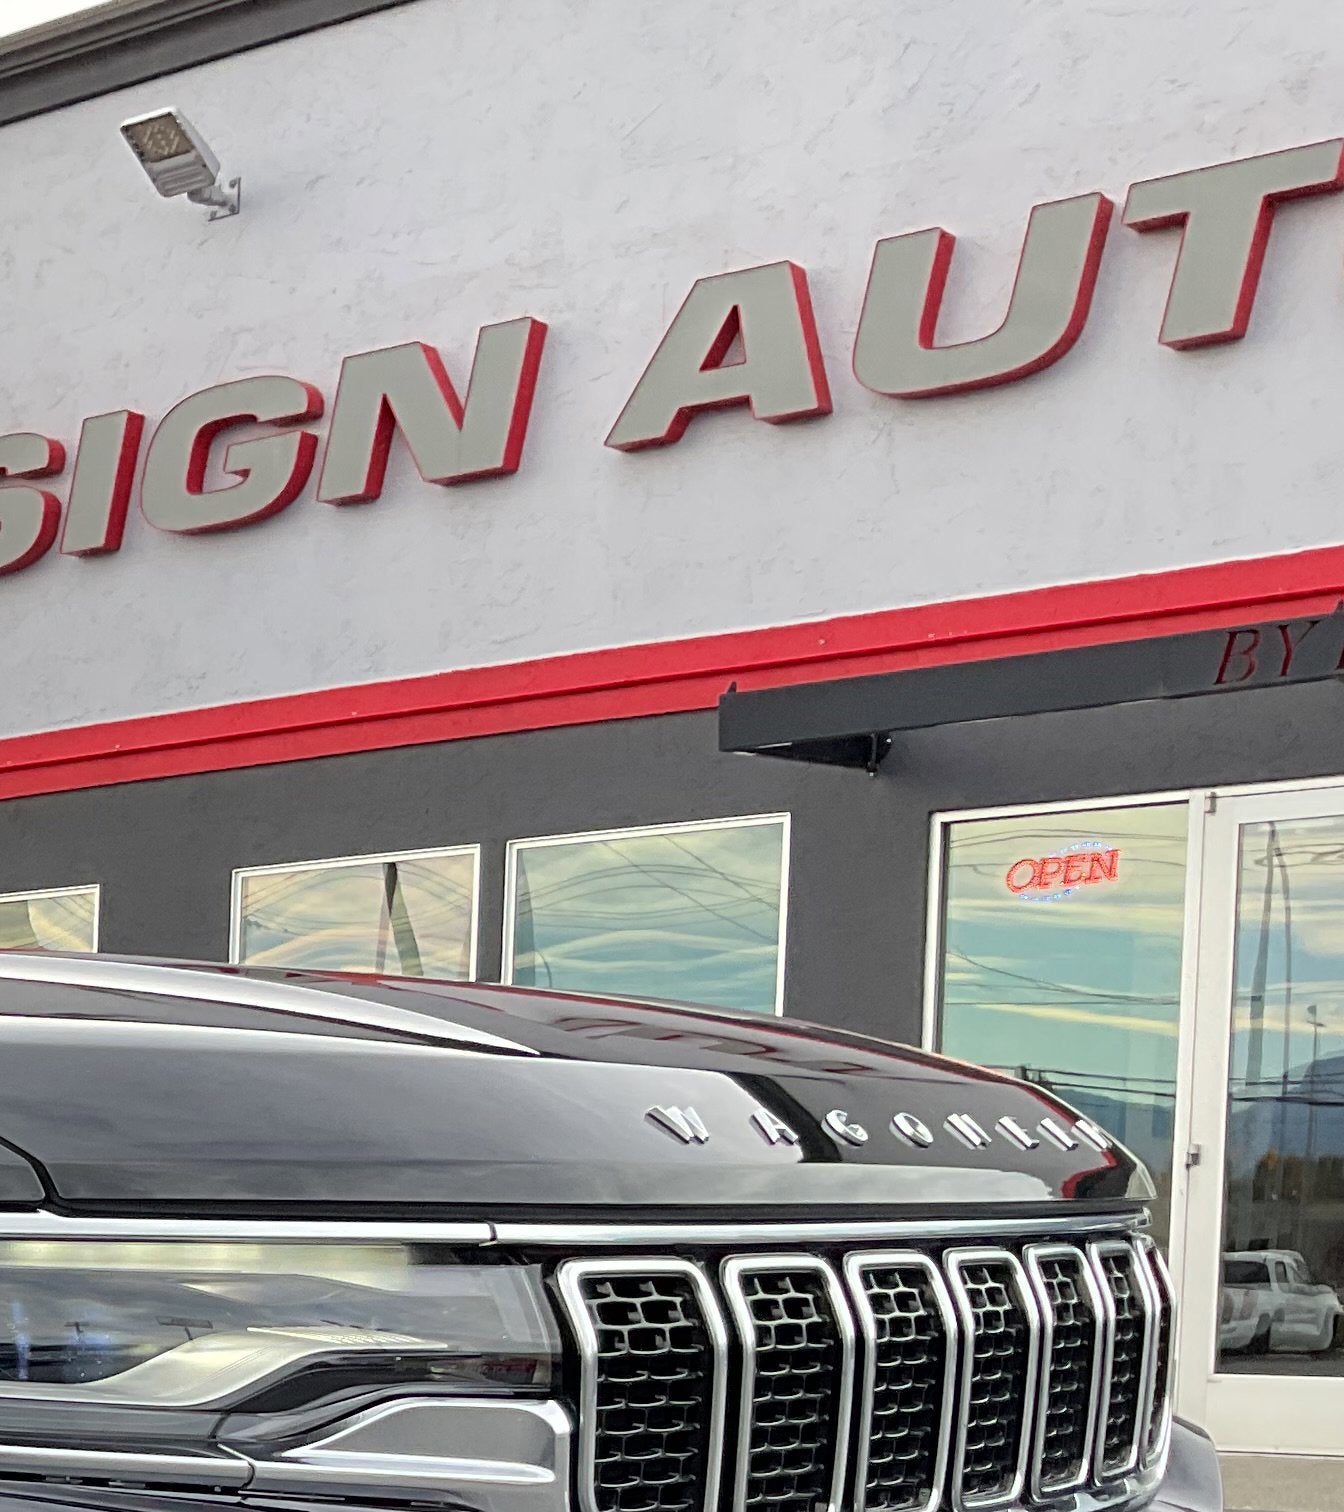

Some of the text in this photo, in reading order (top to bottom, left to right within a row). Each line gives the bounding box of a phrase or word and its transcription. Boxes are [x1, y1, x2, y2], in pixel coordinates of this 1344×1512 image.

[604, 137, 1344, 453] AUT
[1214, 620, 1320, 685] BY
[1006, 849, 1121, 893] OPEN
